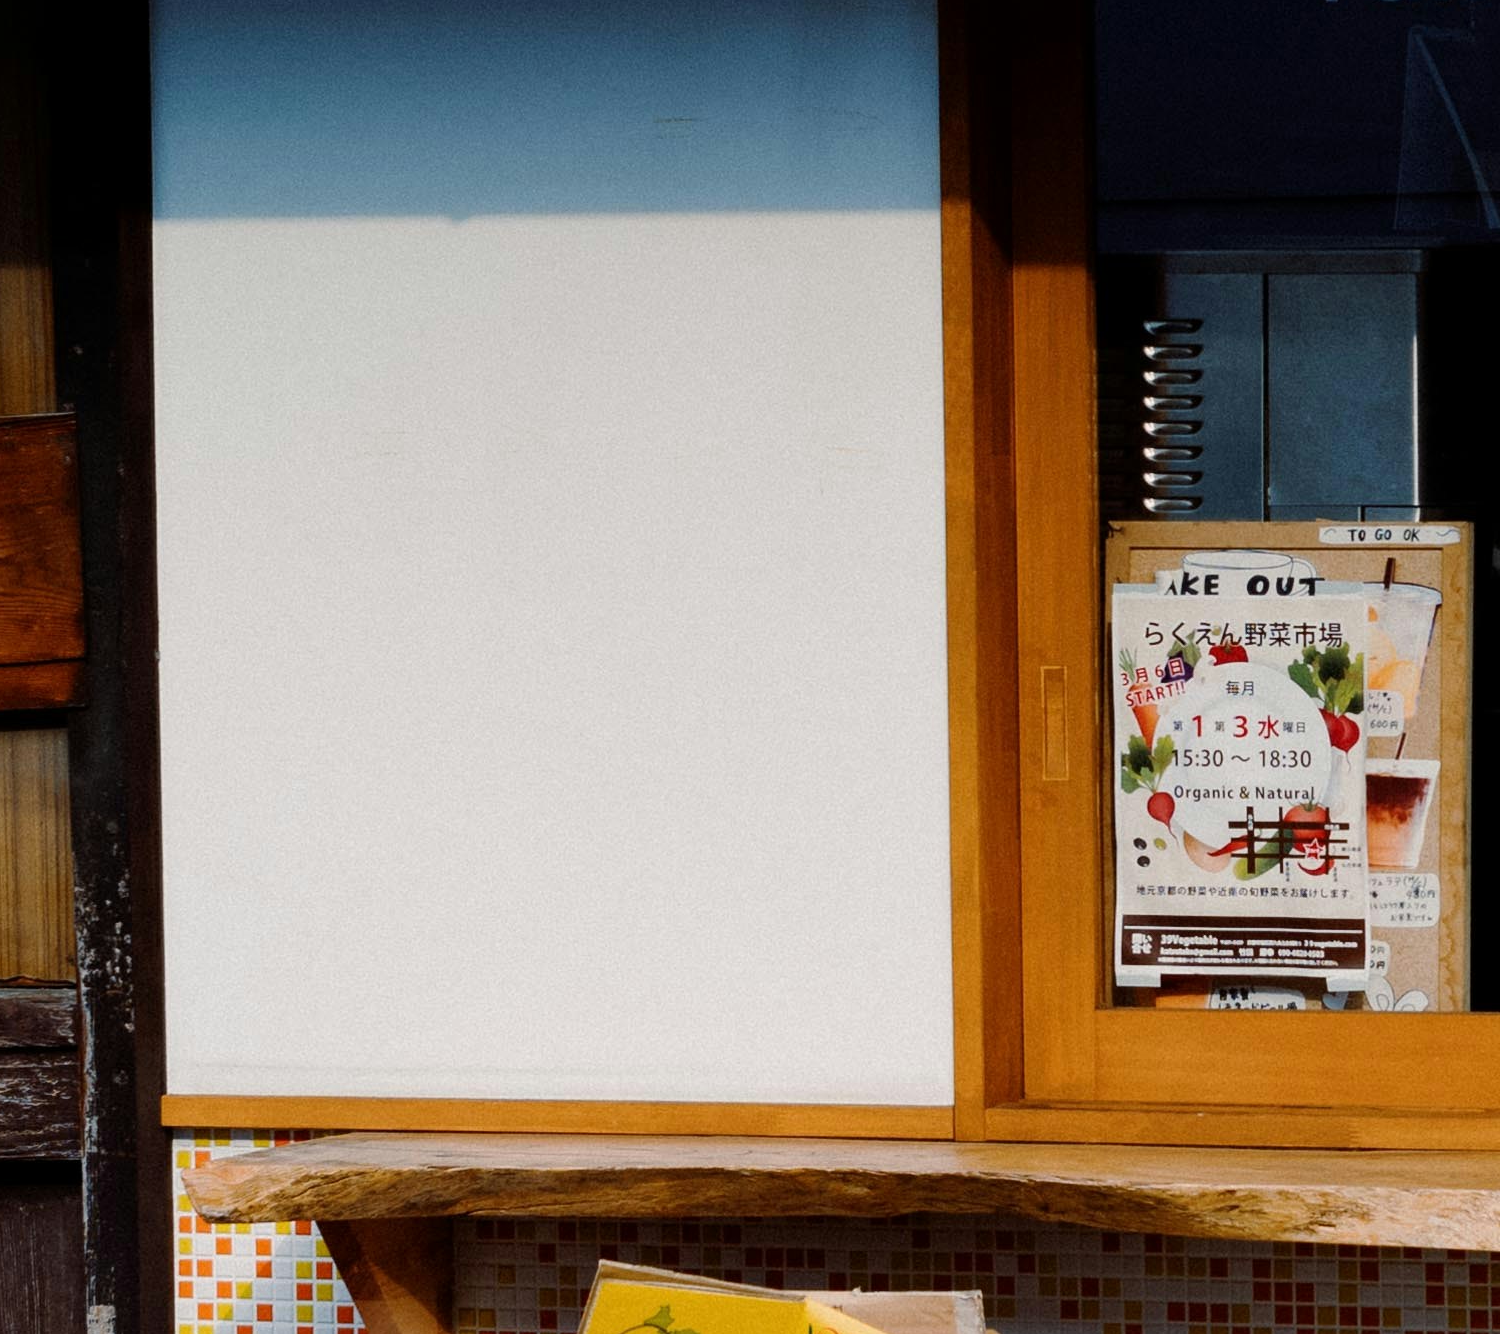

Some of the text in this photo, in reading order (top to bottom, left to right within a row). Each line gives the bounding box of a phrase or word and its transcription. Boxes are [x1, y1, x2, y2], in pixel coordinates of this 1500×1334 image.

[1348, 528, 1420, 542] TO GO OK
[1164, 572, 1325, 596] AKE OUT
[1144, 621, 1344, 648] らくえん野菜市場
[1120, 658, 1186, 686] 3月6日
[1125, 680, 1186, 707] START!!
[1225, 680, 1255, 696] 毎月
[1172, 749, 1224, 767] 15:30
[1259, 749, 1312, 767] 18:30
[1174, 785, 1316, 802] Organic & Natural
